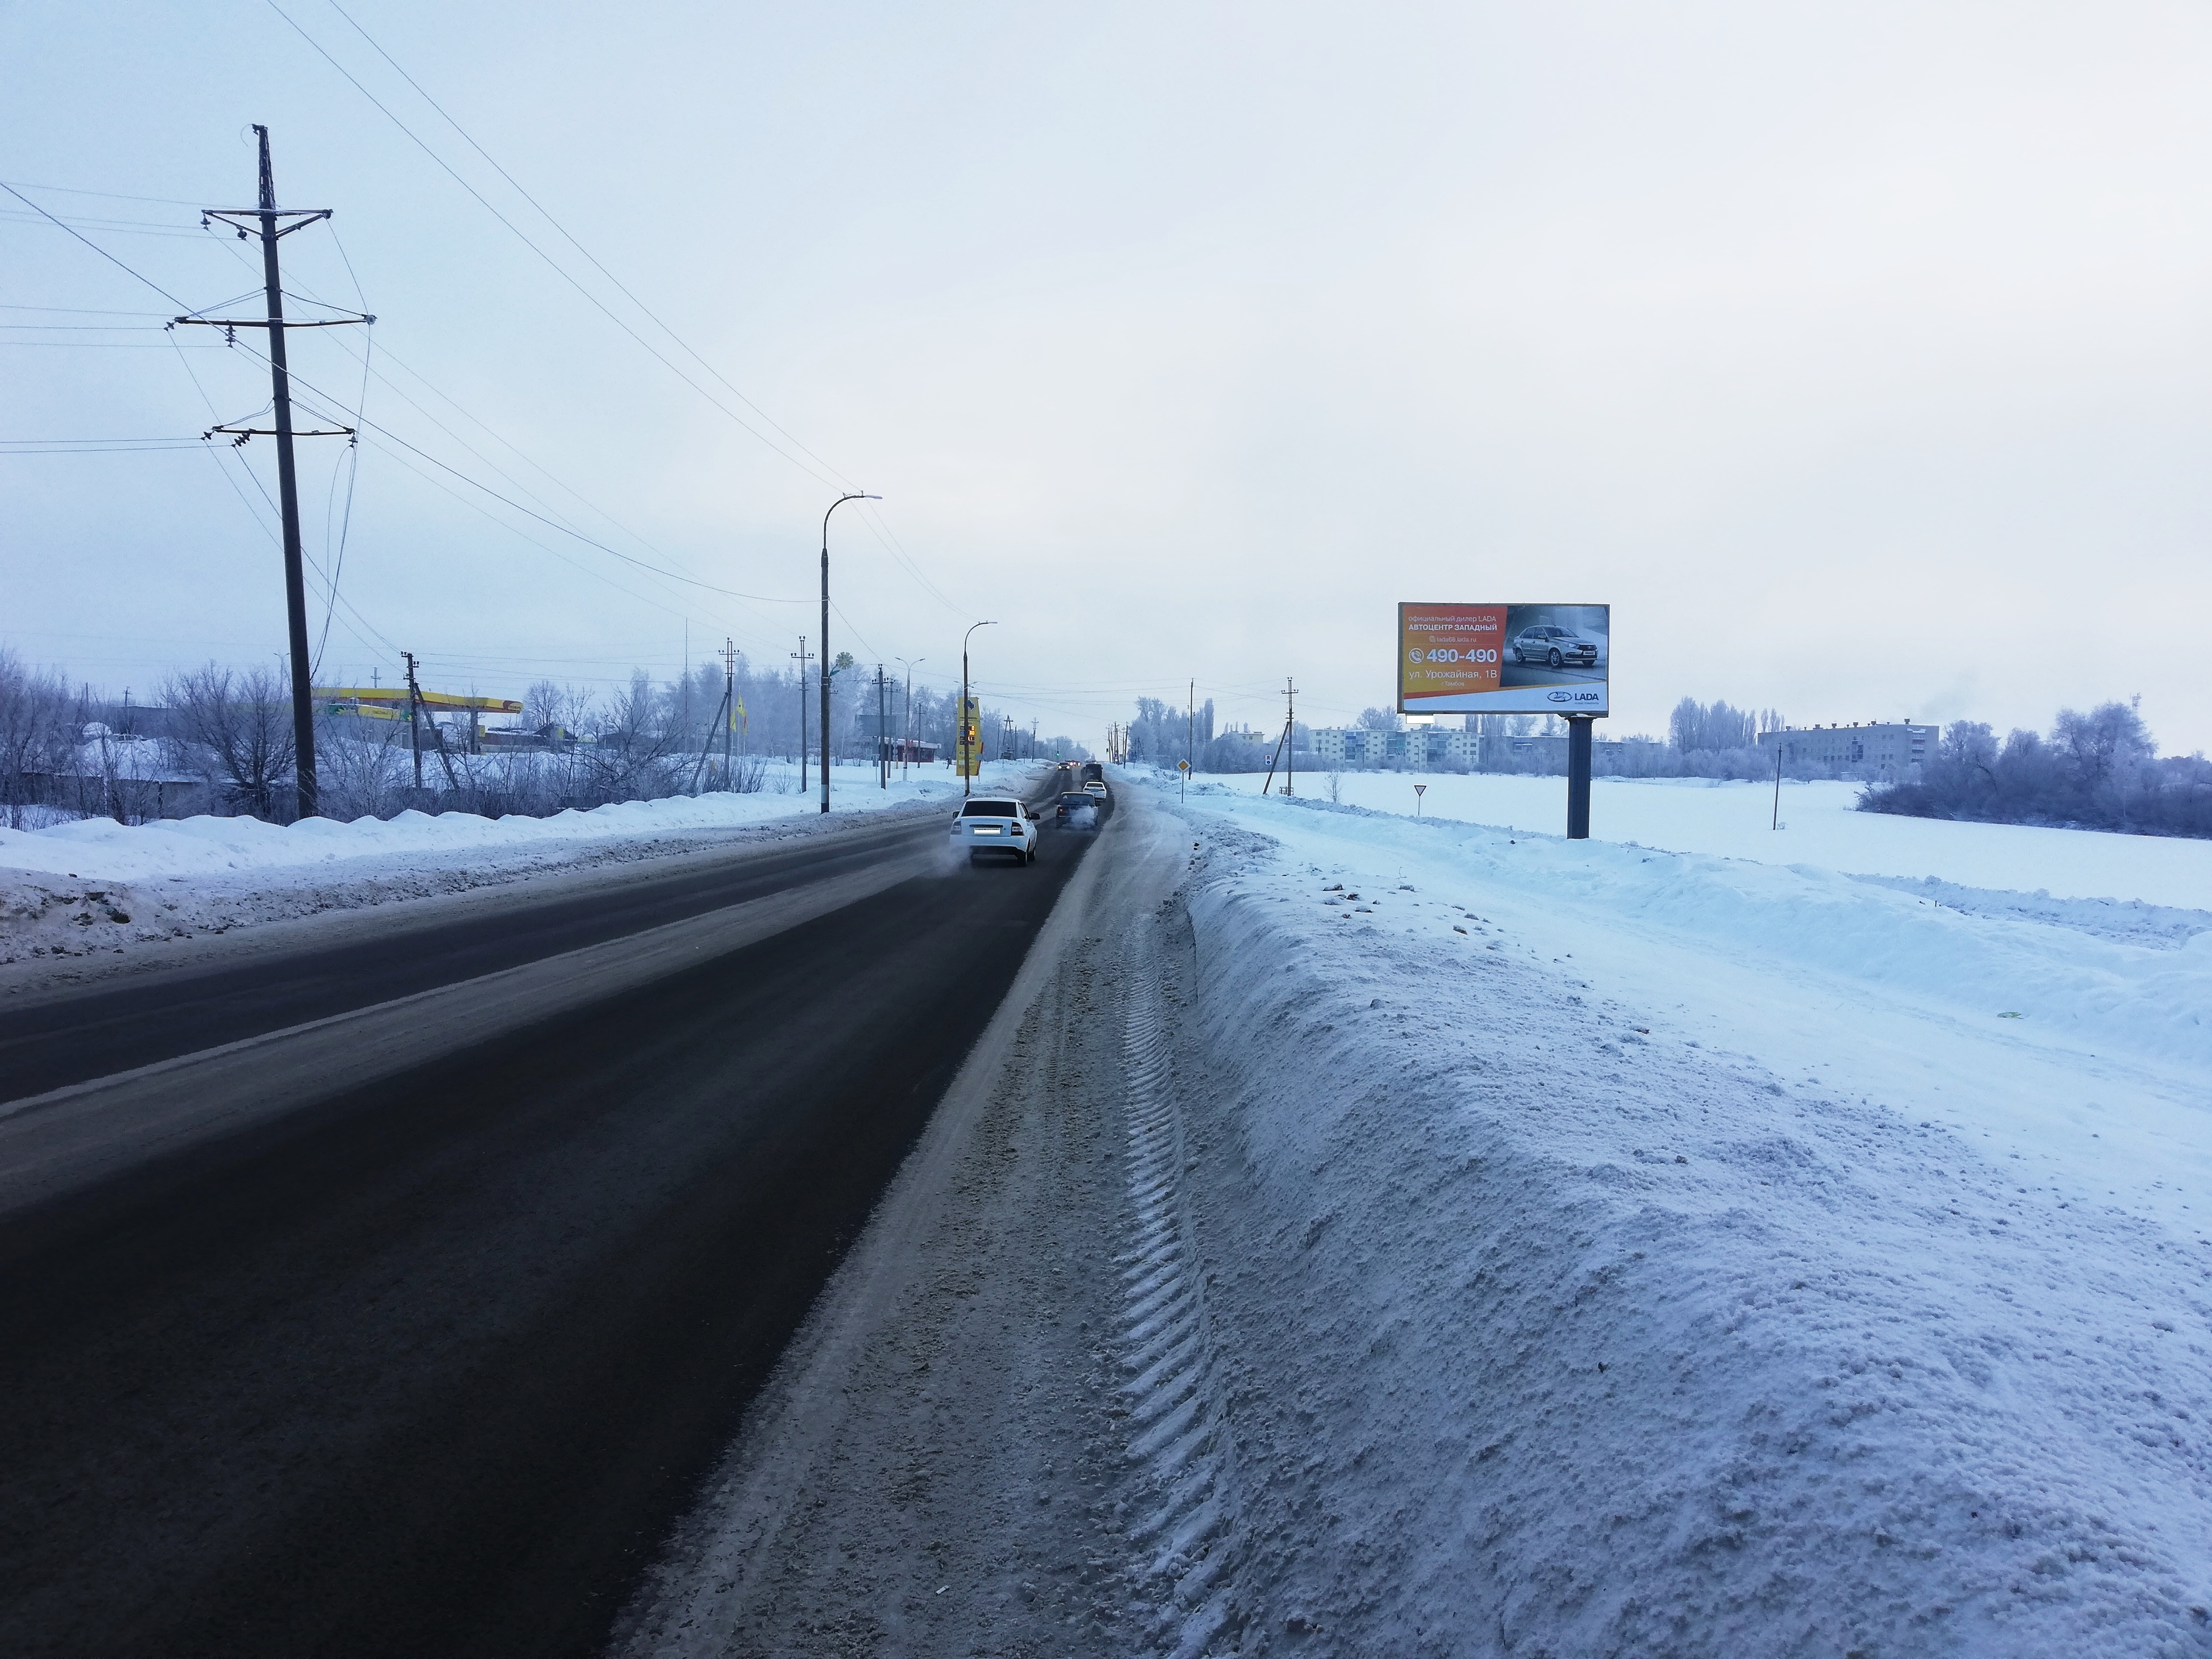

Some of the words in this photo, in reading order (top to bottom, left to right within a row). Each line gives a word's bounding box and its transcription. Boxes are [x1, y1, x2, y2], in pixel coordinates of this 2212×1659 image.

[1426, 649, 1497, 663] 490-490
[1409, 672, 1422, 680] ул.
[1426, 670, 1481, 680] Урожайная,
[1486, 670, 1497, 678] 1В
